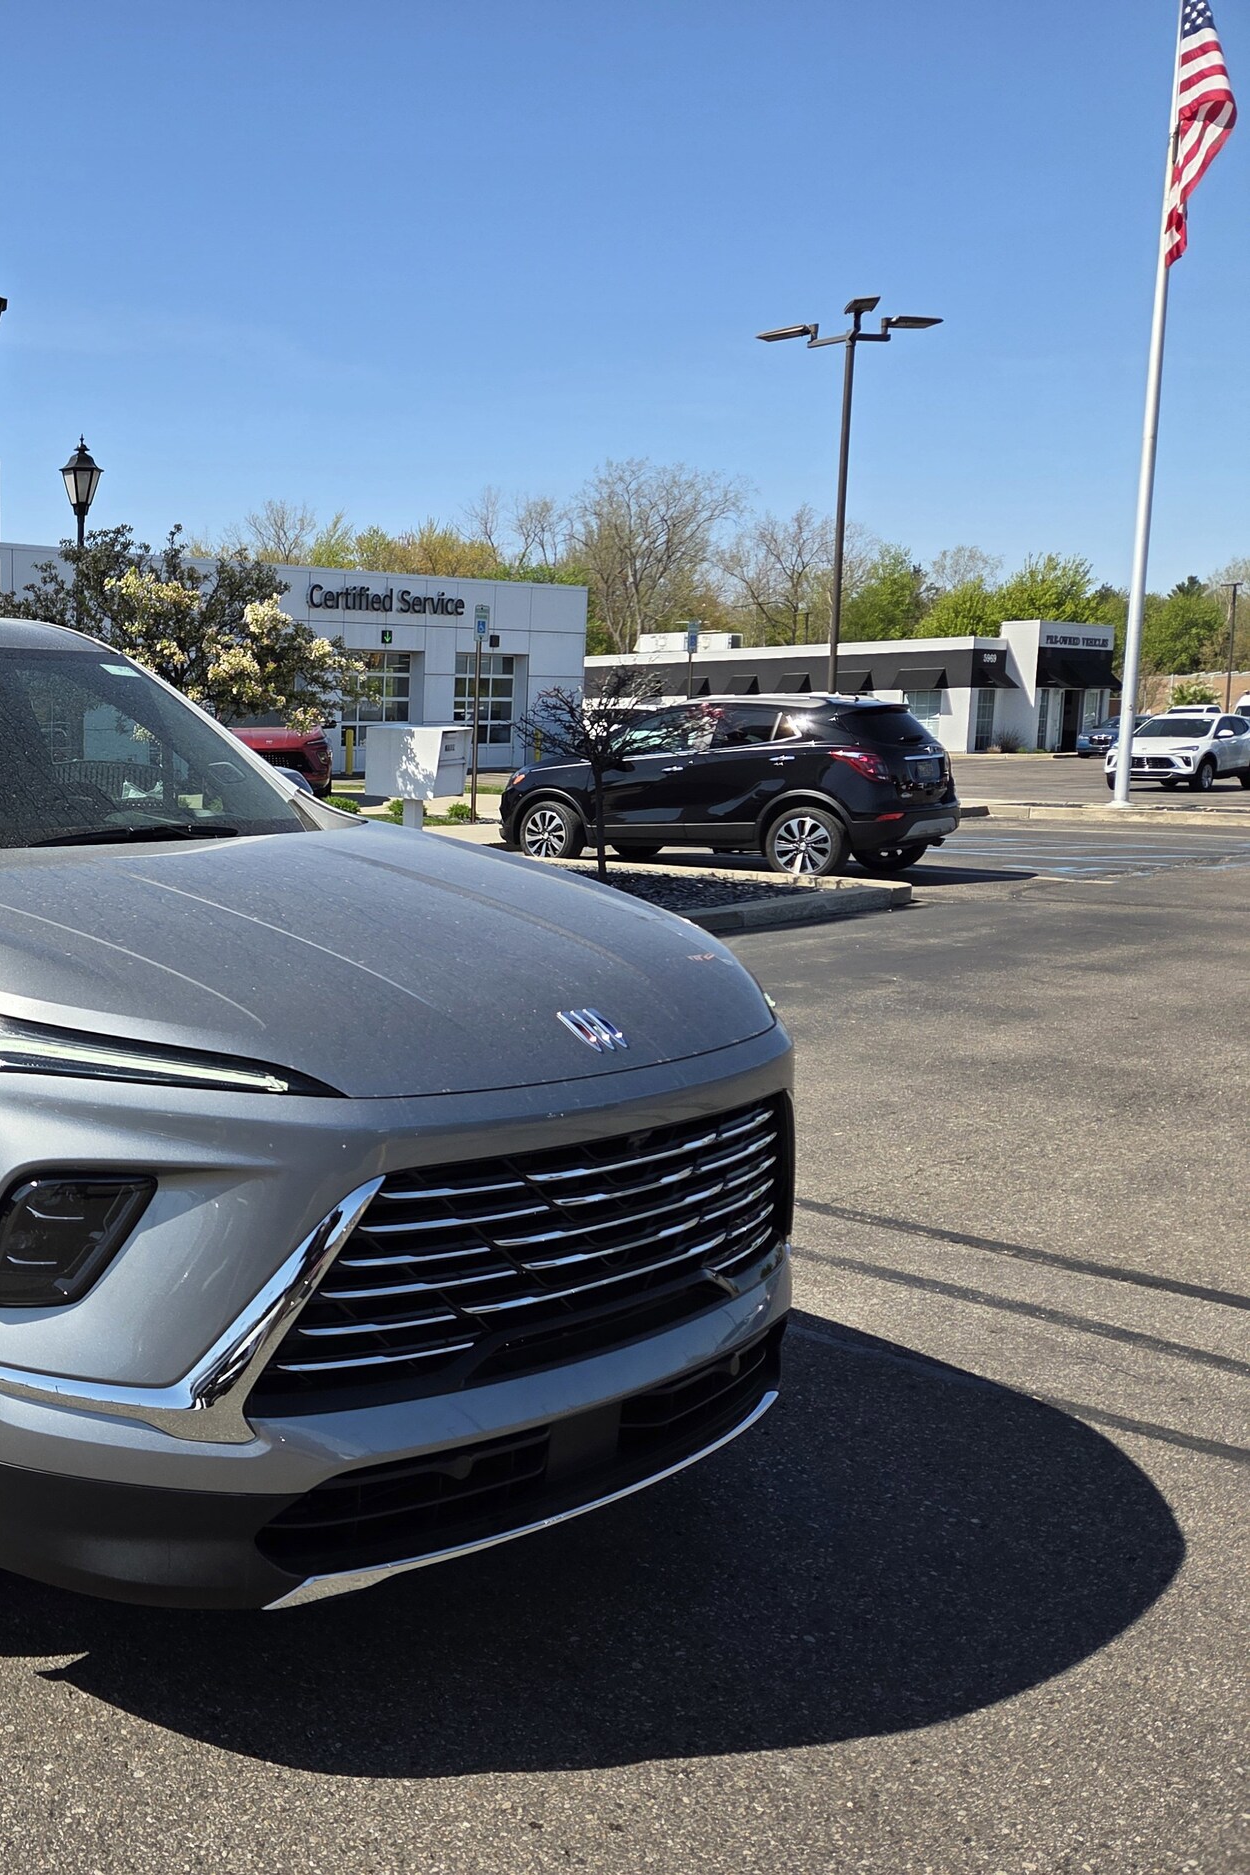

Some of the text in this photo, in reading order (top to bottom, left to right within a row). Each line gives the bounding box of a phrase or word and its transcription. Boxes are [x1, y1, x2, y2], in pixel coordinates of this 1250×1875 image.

[307, 583, 465, 616] Certified Service
[1046, 635, 1109, 648] PRE-OWNED VEHICLES
